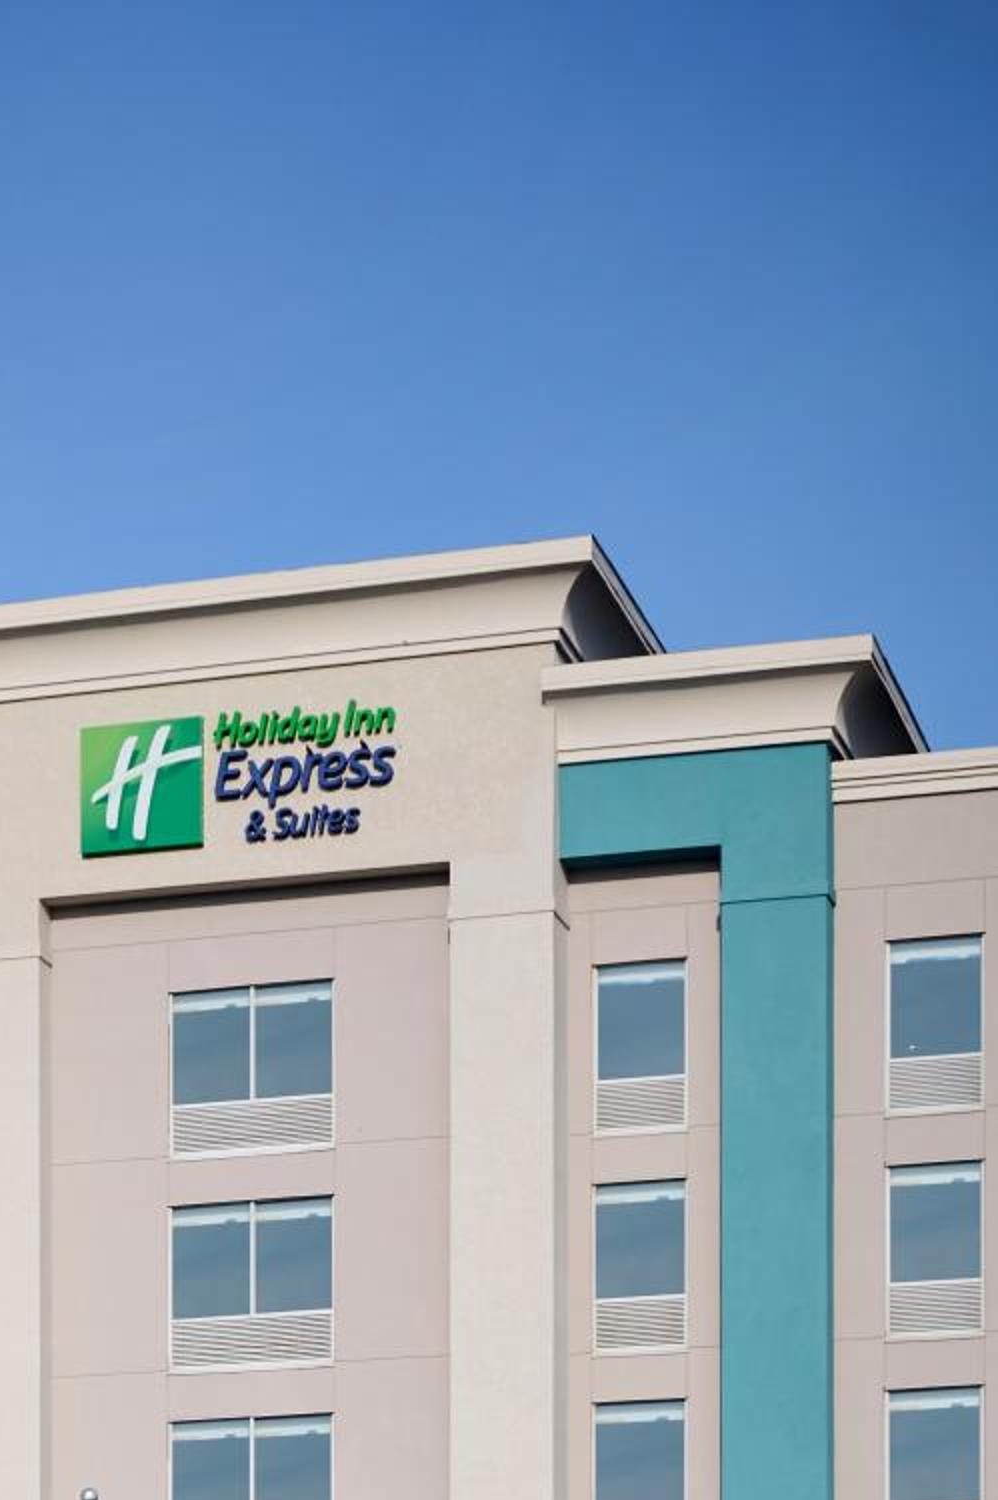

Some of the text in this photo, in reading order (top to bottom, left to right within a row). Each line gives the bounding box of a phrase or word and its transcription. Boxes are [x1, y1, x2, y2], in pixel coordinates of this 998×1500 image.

[213, 699, 396, 748] Holiday Inn
[91, 725, 202, 841] H
[215, 744, 397, 809] Express
[244, 805, 361, 844] & Suites
